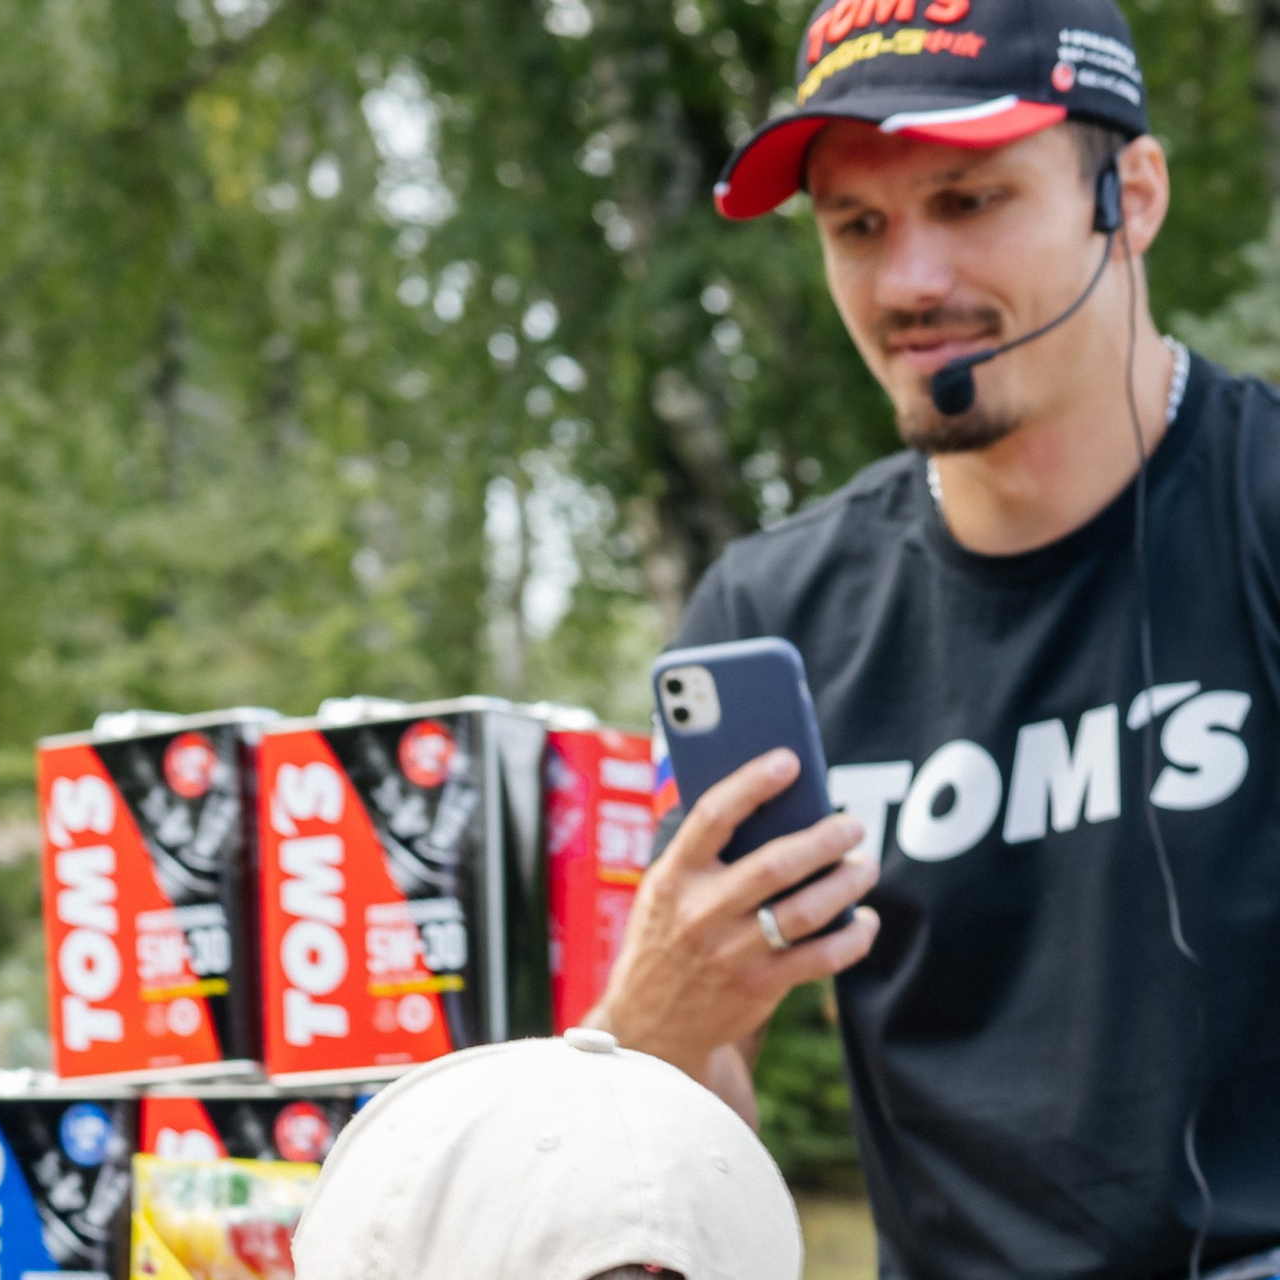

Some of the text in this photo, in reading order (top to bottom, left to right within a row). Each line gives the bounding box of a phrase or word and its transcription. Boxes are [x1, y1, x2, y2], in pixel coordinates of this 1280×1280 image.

[47, 773, 123, 1051] TOM'S
[270, 761, 349, 1047] TOM'S
[827, 680, 1252, 866] TOM'S
